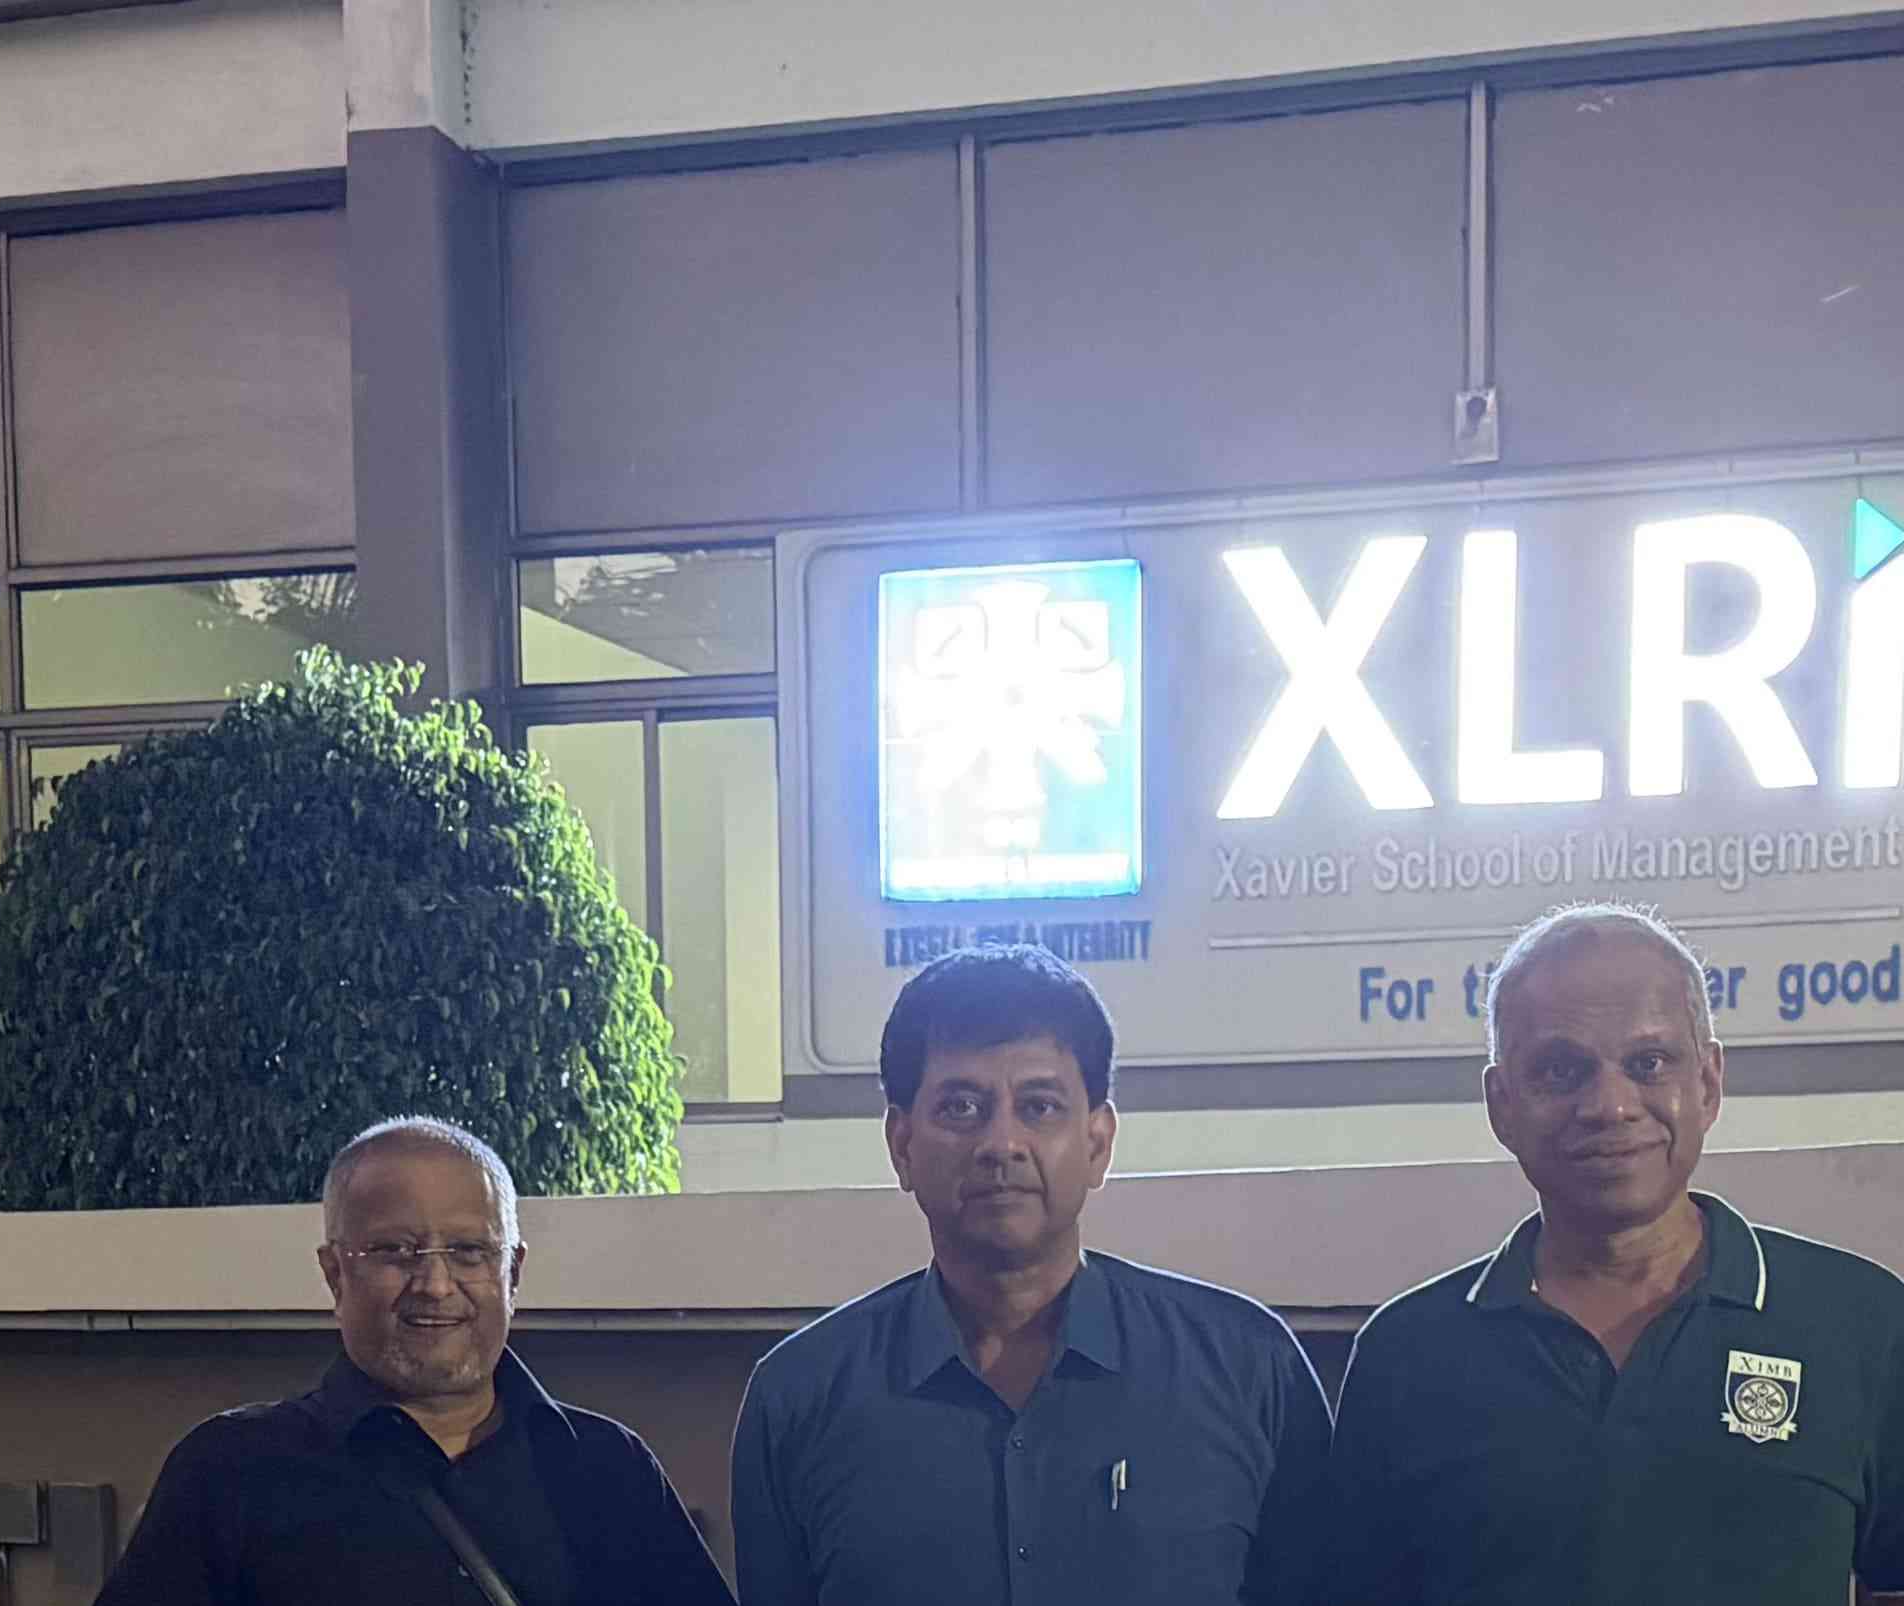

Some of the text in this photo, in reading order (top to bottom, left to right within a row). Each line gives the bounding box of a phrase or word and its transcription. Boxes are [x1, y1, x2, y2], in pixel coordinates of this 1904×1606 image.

[1213, 816, 1903, 899] Xavier School of Management
[1359, 965, 1435, 1022] For
[1778, 943, 1902, 1021] good
